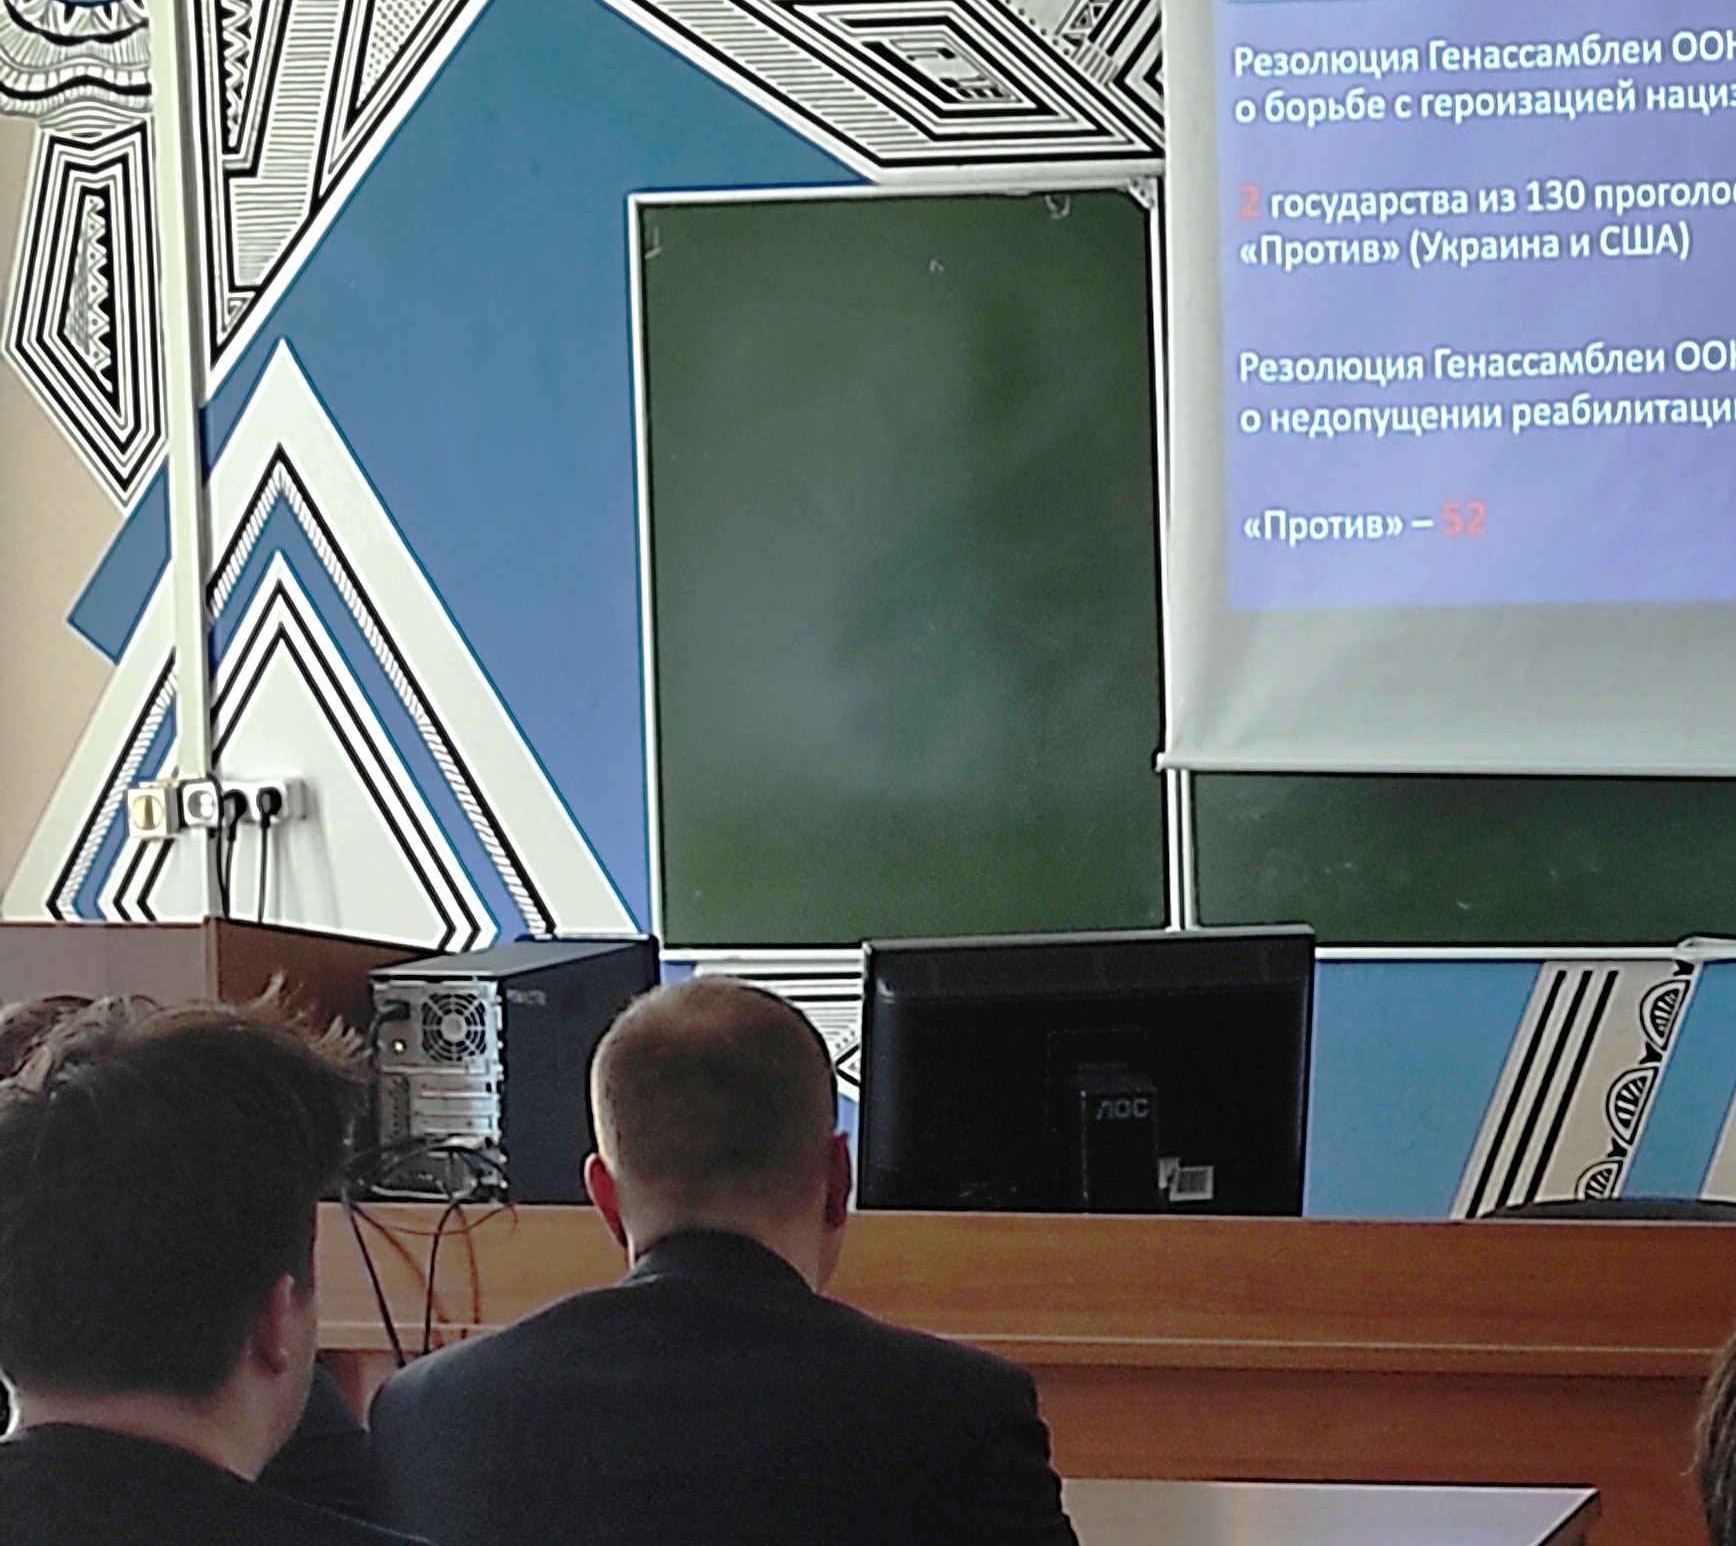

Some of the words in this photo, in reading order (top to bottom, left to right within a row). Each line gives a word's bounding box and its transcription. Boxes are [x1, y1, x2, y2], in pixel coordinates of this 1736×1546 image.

[1235, 47, 1419, 79] Резолюция
[1429, 33, 1662, 70] Генассамблеи
[1235, 100, 1256, 122] о
[1265, 87, 1385, 128] борьбе
[1394, 95, 1411, 118] с
[1421, 79, 1636, 124] героизацией
[1240, 185, 1259, 219] 2
[1271, 191, 1468, 224] государства
[1479, 189, 1516, 212] из
[1527, 179, 1585, 211] 130
[1240, 235, 1399, 272] «Против»
[1410, 230, 1559, 269] (Украина
[1570, 234, 1590, 257] и
[1600, 220, 1689, 260] США)
[1240, 352, 1424, 387] Резолюция
[1435, 341, 1665, 379] Генассамблеи
[1240, 410, 1261, 432] о
[1271, 405, 1502, 438] недопущении
[1244, 510, 1403, 547] «Против»
[1443, 501, 1485, 535] 52
